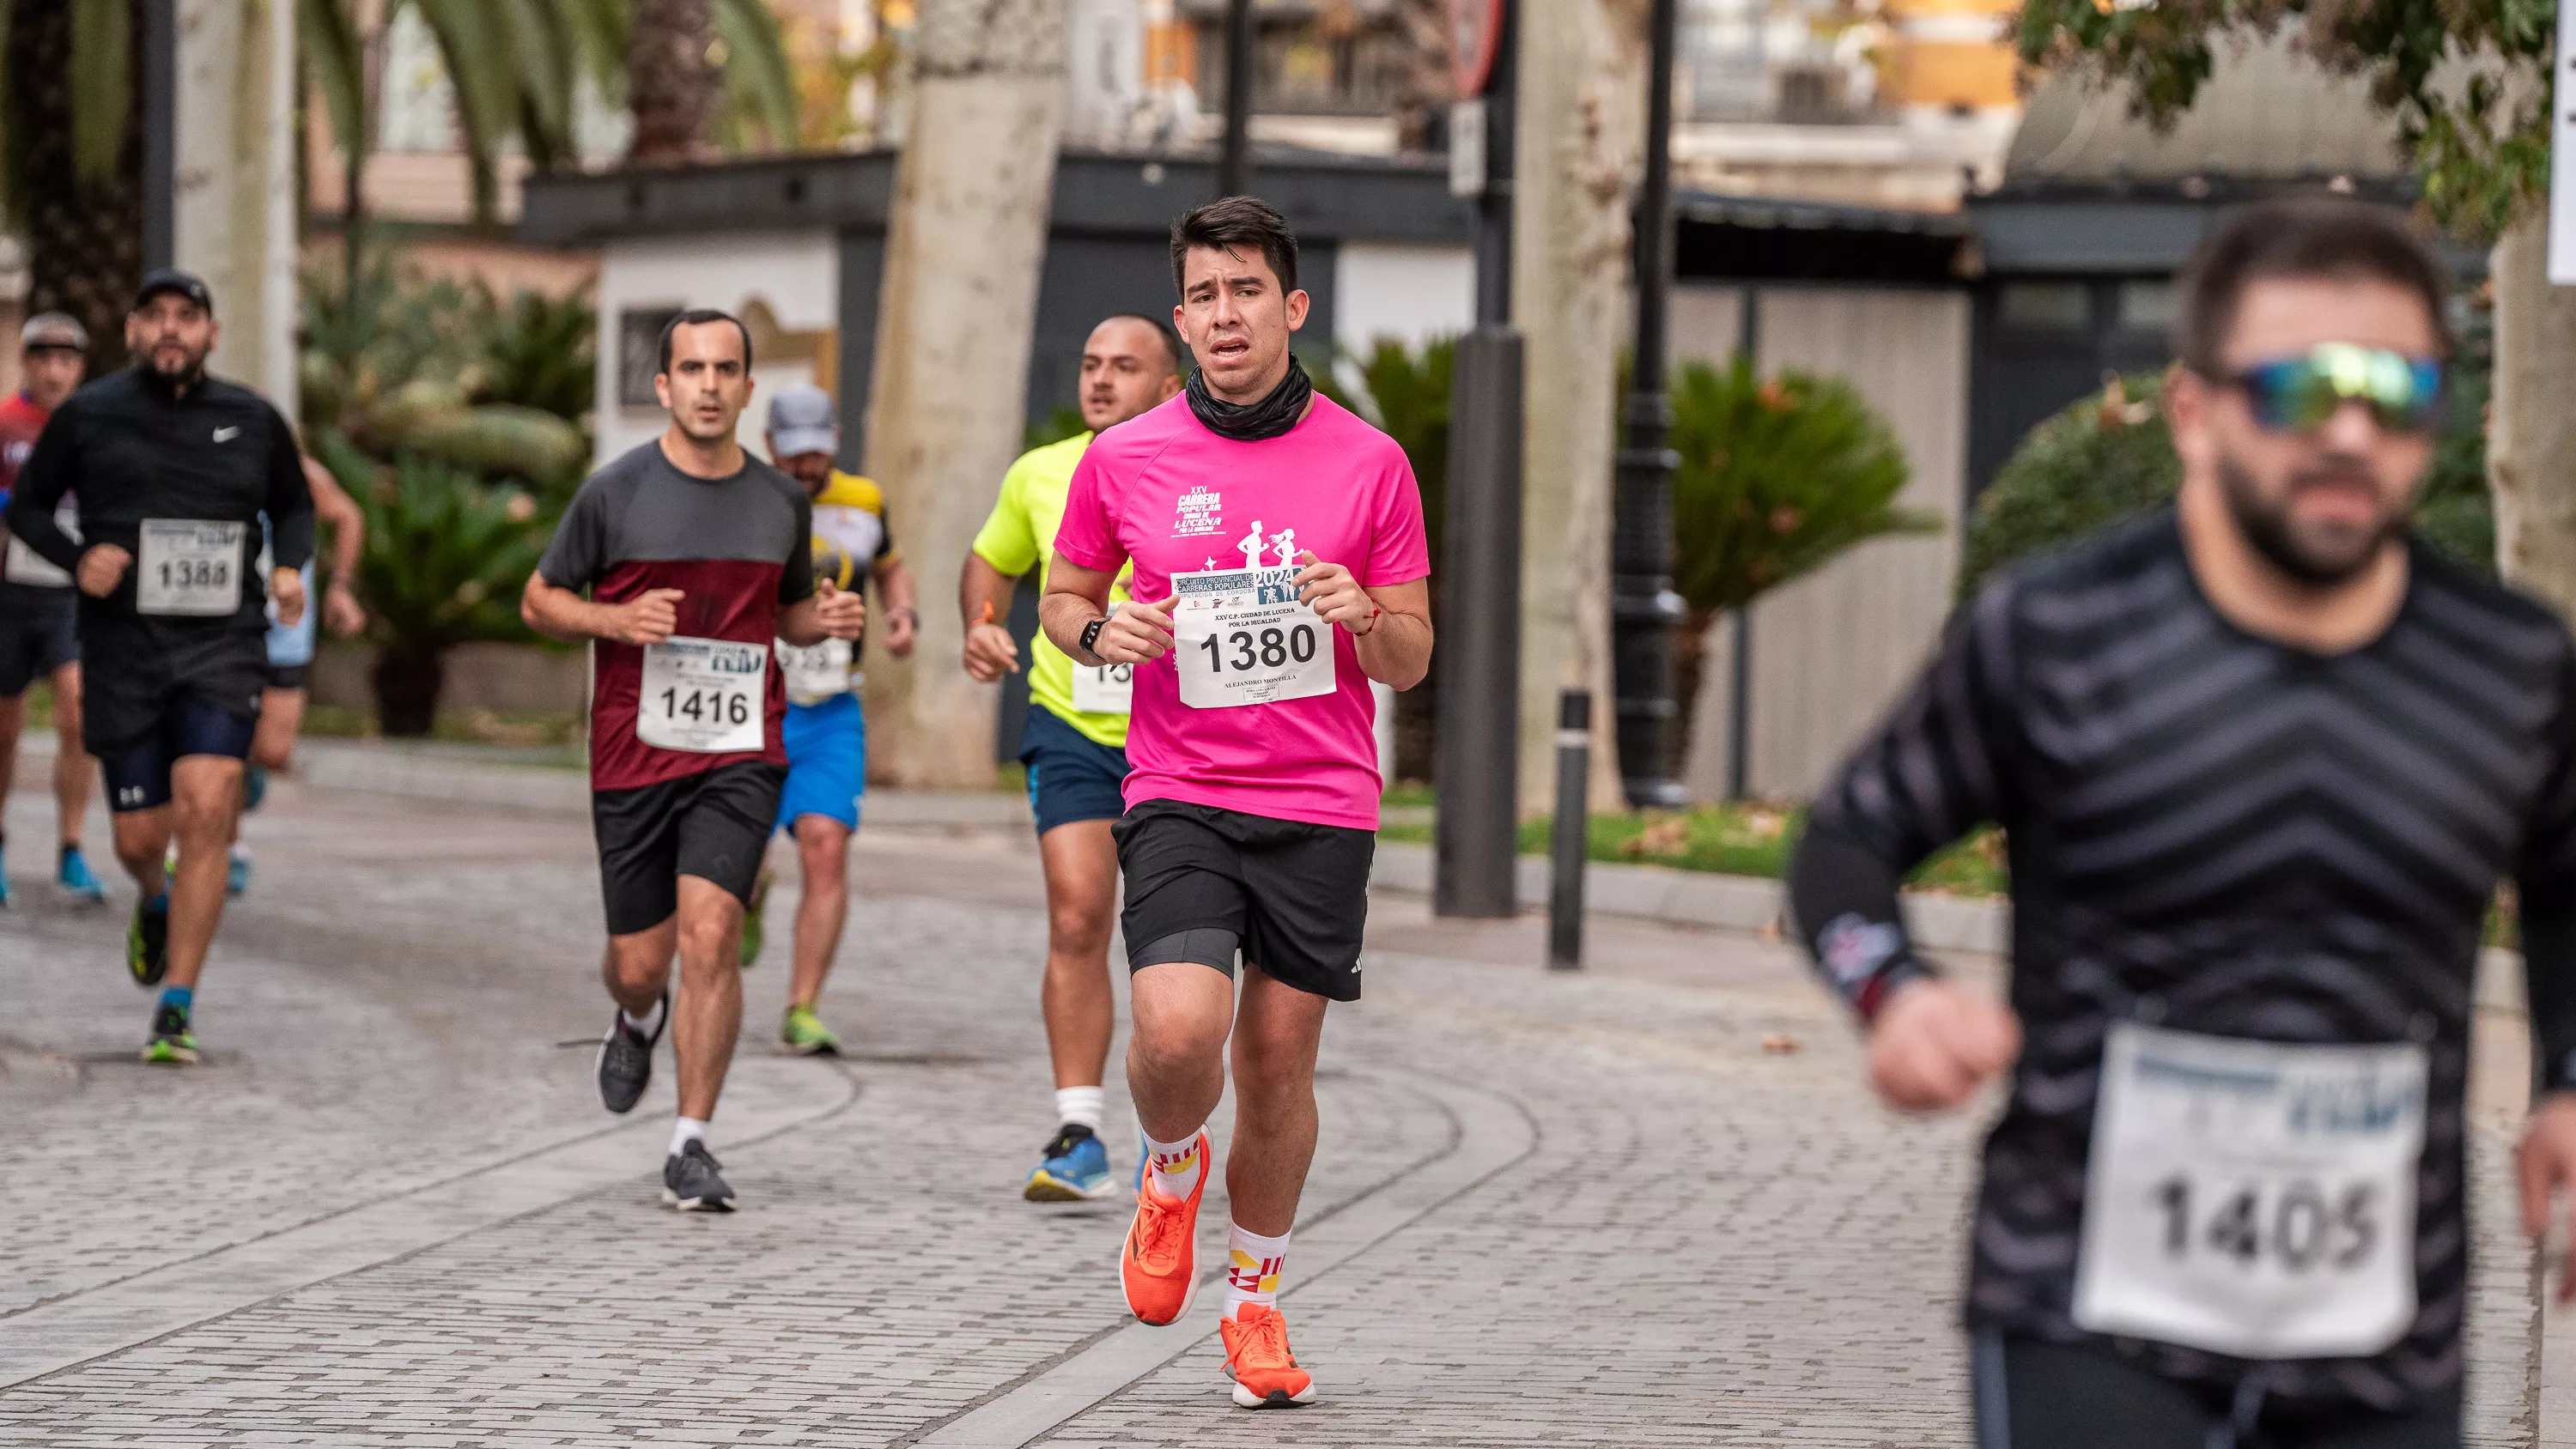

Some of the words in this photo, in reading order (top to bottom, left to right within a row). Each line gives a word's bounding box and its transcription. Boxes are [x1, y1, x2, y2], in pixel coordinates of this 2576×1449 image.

[1191, 486, 1206, 494] XXV
[1177, 492, 1220, 507] CARRERA
[1176, 504, 1221, 513] POPULAR
[1174, 517, 1222, 529] LUCENA
[1206, 574, 1244, 584] PROVINCIAL
[1177, 585, 1212, 593] CARRERAS
[1214, 580, 1255, 590] POPULARES
[1250, 617, 1281, 626] IGUALDAD
[1200, 624, 1316, 673] 1380
[1224, 679, 1262, 688] ALEJANDRO
[1263, 675, 1297, 684] MONTILLA
[660, 686, 748, 724] 1416
[2149, 1169, 2379, 1272] 1405
